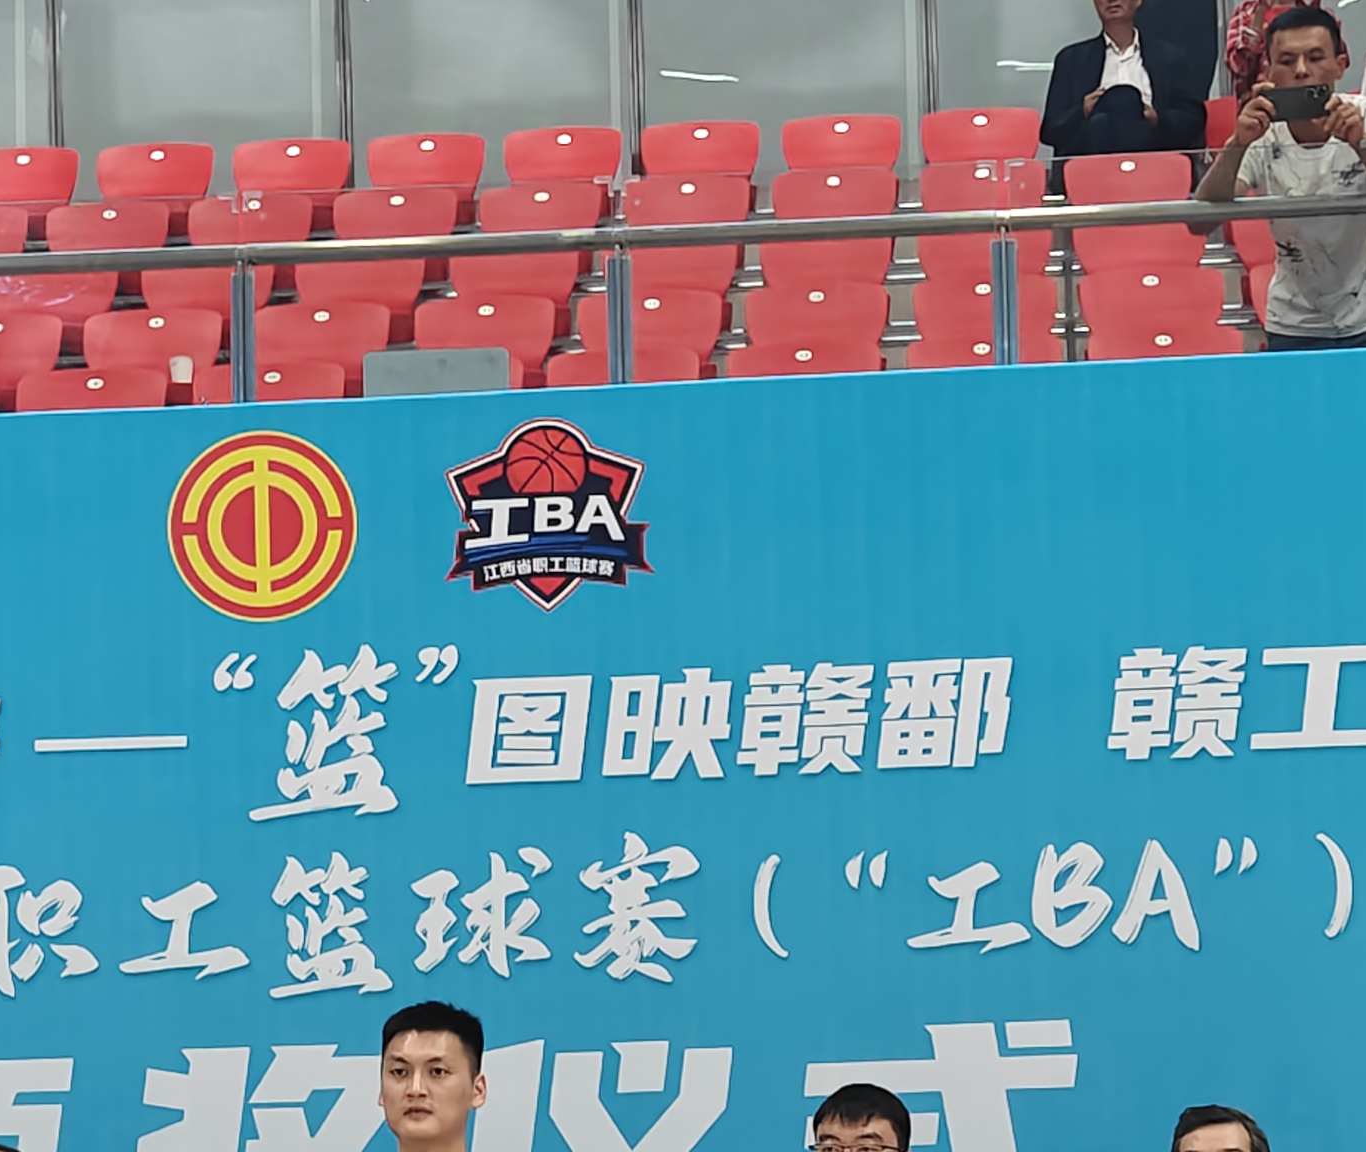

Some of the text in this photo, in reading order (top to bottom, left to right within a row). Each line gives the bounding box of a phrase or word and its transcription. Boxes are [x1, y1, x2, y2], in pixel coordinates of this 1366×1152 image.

[482, 556, 615, 582] 江西省职工篮球赛
